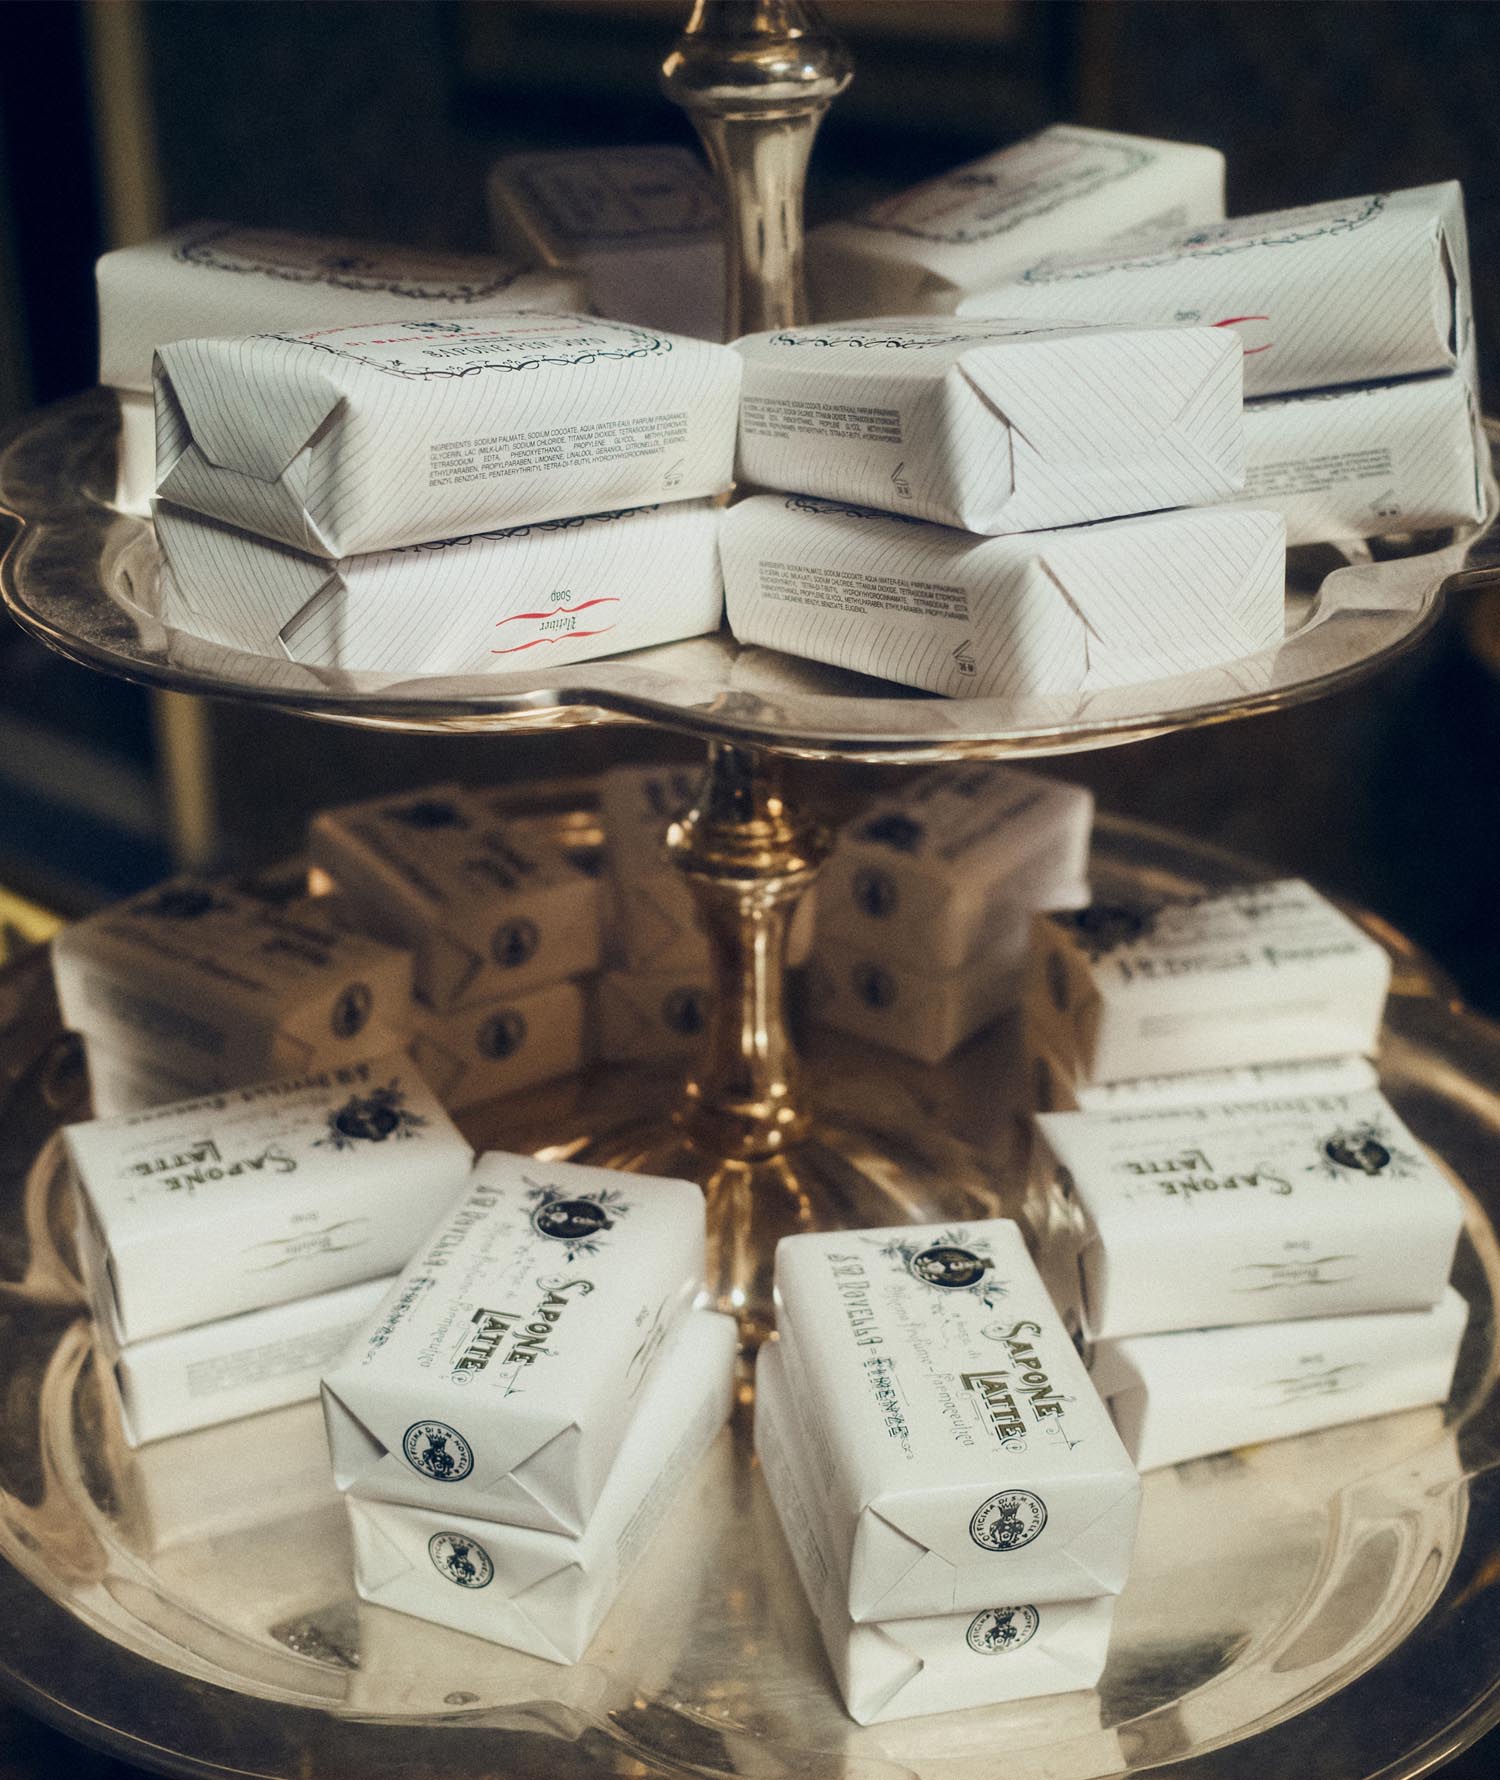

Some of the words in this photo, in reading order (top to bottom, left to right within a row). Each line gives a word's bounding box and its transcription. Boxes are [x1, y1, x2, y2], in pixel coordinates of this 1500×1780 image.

[550, 589, 572, 602] Soap
[131, 1140, 222, 1176] LATTE
[164, 1150, 297, 1191] SAPONE
[1127, 1150, 1213, 1176] LATTE
[1162, 1167, 1292, 1198] SAPONE
[454, 1308, 521, 1372] LATTE
[502, 1279, 594, 1366] SAPONE
[981, 1321, 1070, 1422] SAPONE
[960, 1371, 1027, 1441] LATTE
[410, 1429, 425, 1467] OFFICINA
[454, 1440, 467, 1473] NOVELLA
[976, 1503, 995, 1541] OFFICINA
[1021, 1502, 1040, 1538] NOVELLA
